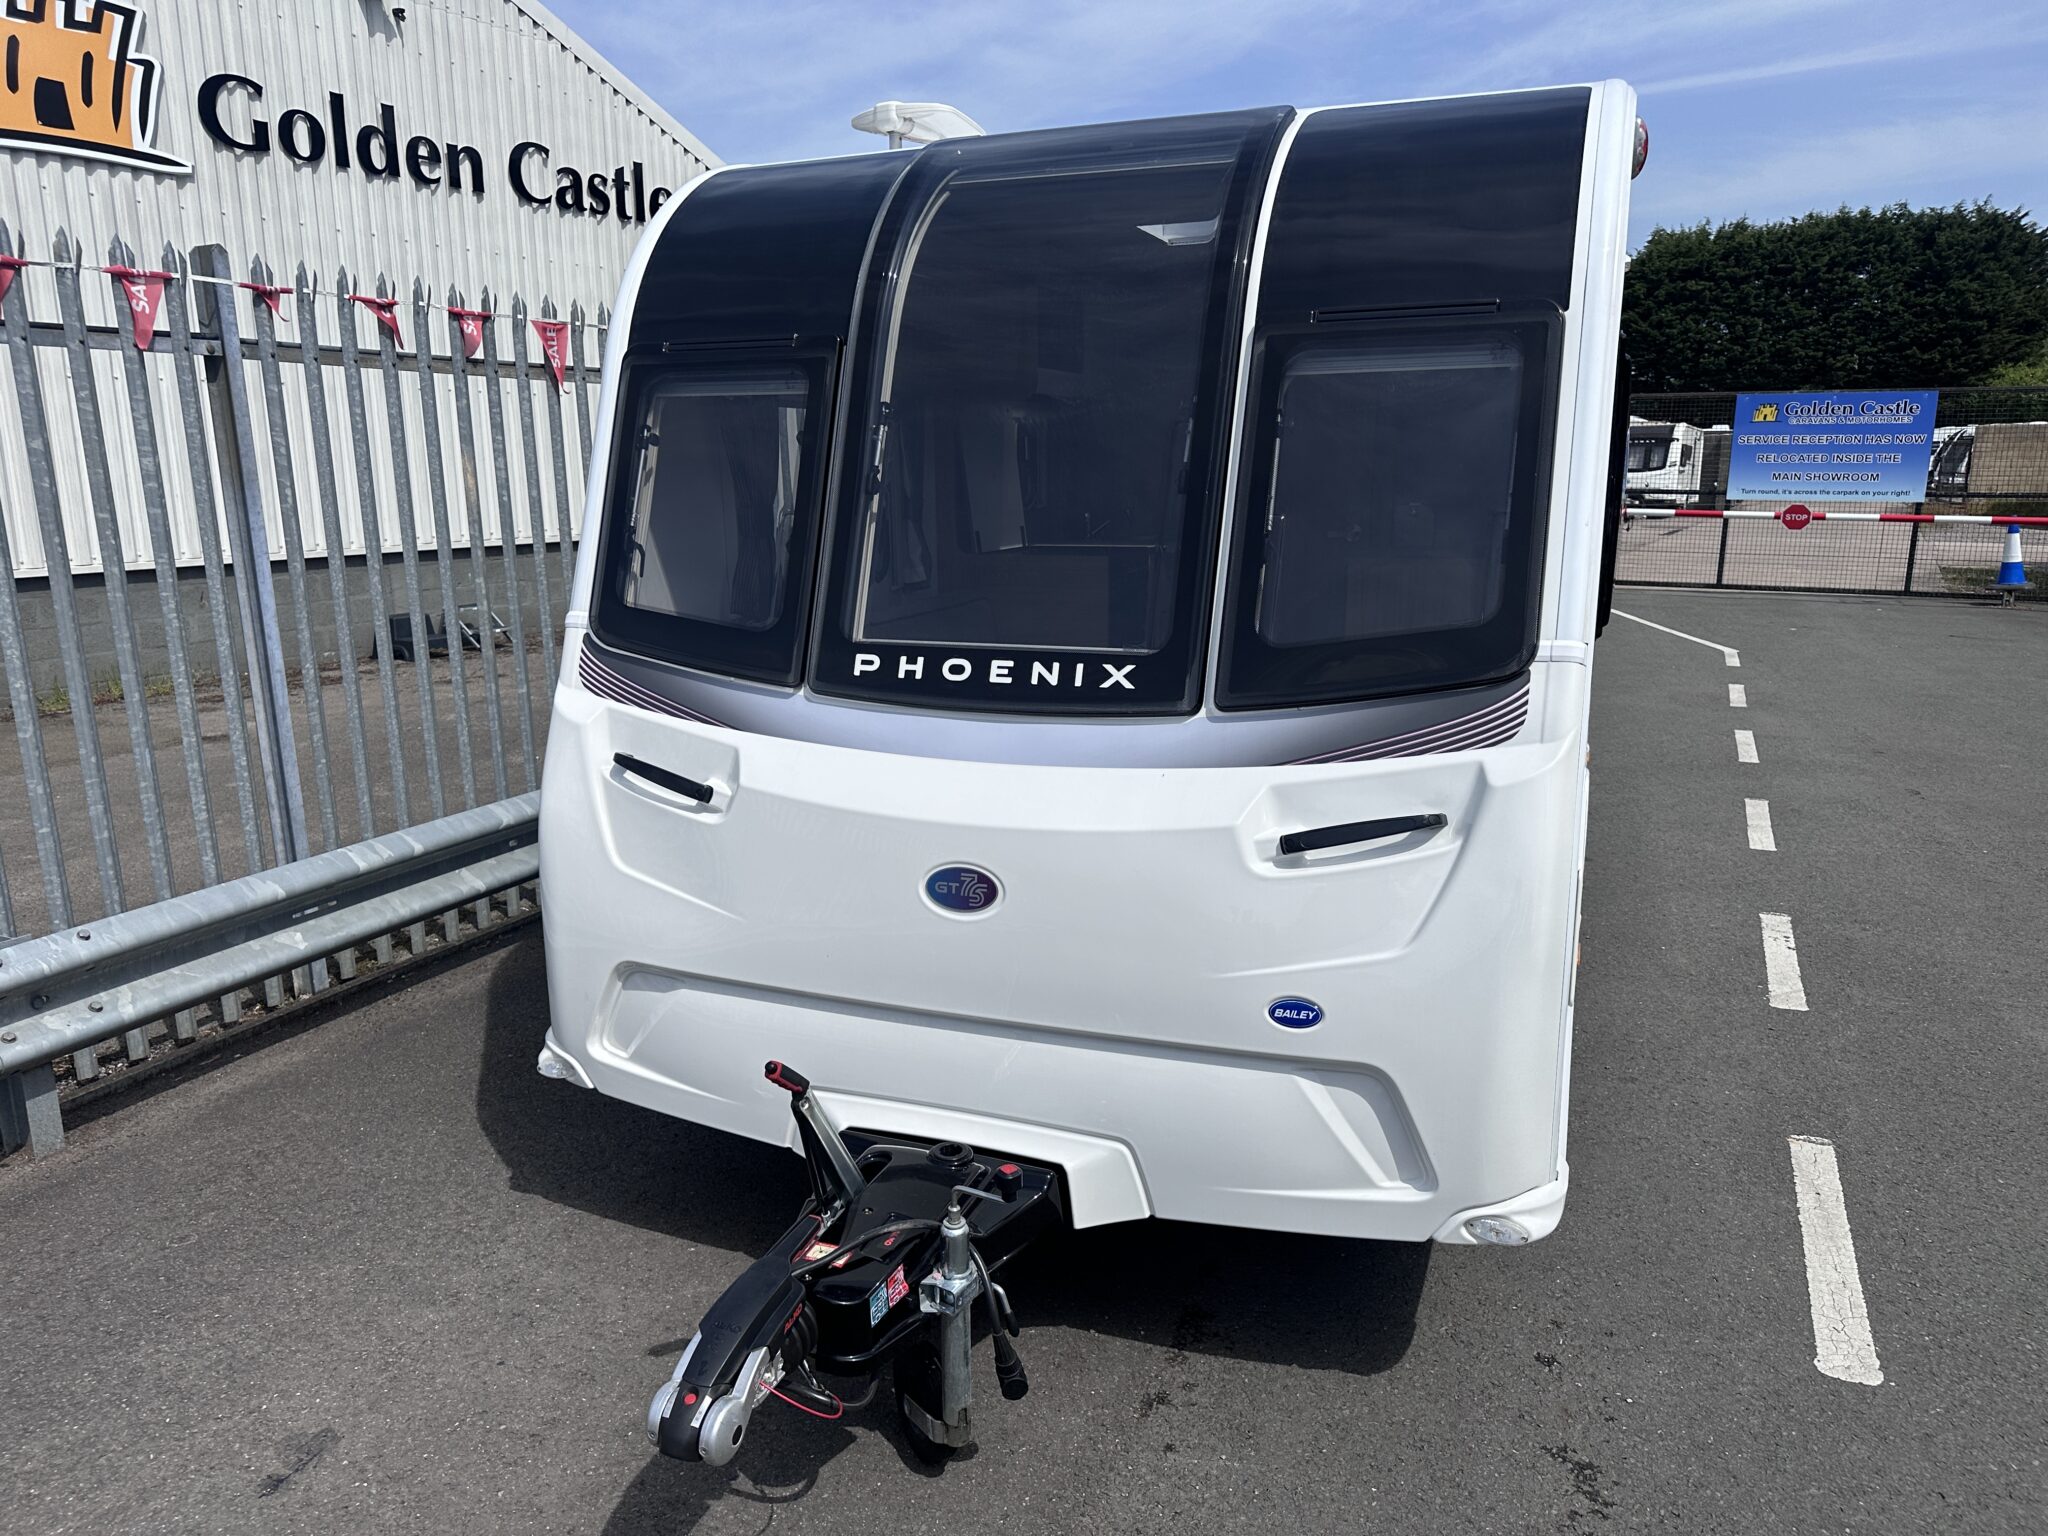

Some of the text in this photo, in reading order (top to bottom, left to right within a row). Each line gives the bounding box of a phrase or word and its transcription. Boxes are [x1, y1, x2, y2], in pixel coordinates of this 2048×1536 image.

[198, 73, 673, 222] Golden Castle
[546, 327, 561, 369] SALE
[1784, 399, 1920, 416] Golden Castle
[1788, 415, 1914, 425] CARAVANS & MOTORHOMES
[1738, 434, 1927, 445] SERVICE RECEPTION HAS NOW
[1756, 453, 1901, 463] RELOCATED INSIDE THE
[1772, 472, 1880, 482] MAIN SHOWROOM
[1891, 489, 1911, 497] right!
[1785, 513, 1808, 521] STOP
[853, 653, 1137, 690] PHOENIX
[1274, 1008, 1317, 1020] BAILEY
